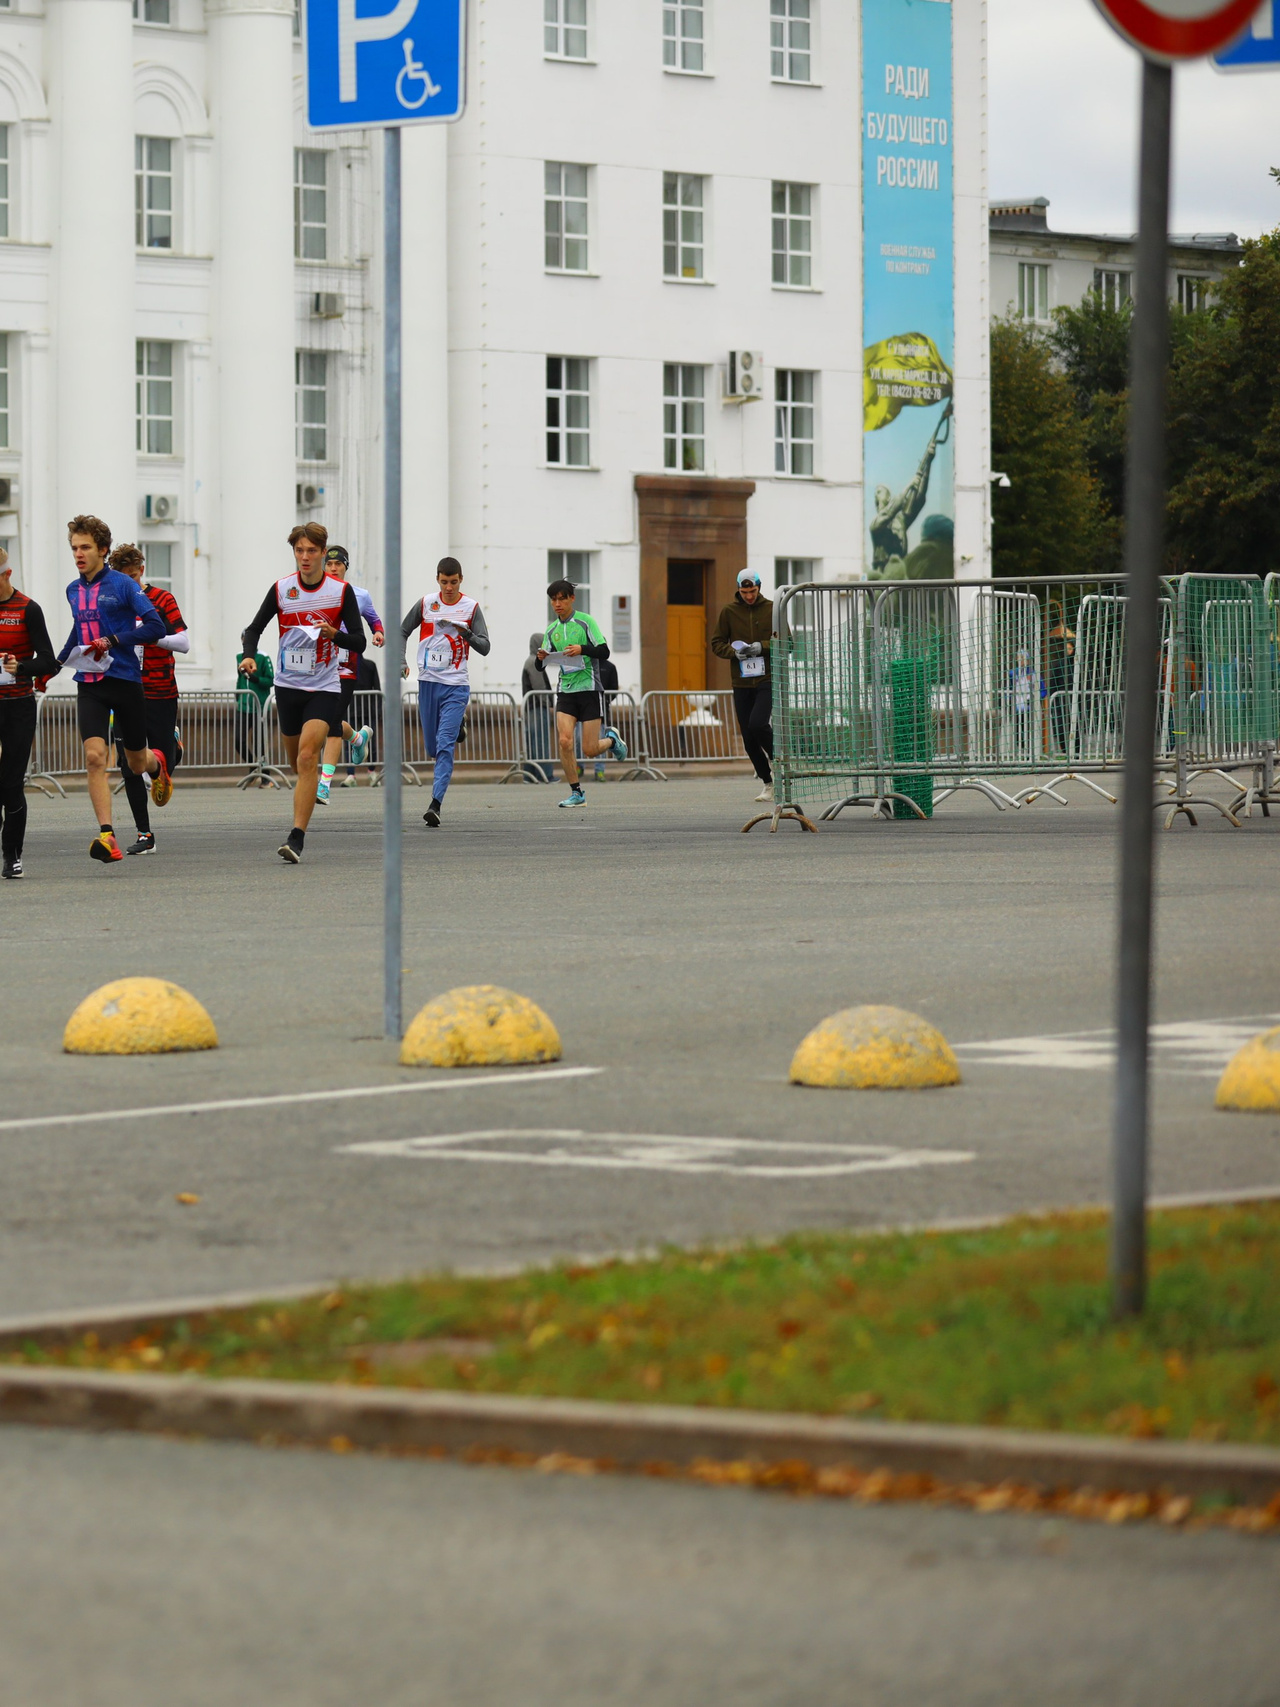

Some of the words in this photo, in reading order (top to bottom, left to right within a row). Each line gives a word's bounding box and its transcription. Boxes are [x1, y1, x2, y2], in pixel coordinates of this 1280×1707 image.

[885, 64, 930, 100] РАДИ
[867, 111, 948, 146] БУДУЩЕГО
[877, 155, 940, 191] РОССИИ
[908, 245, 936, 259] СЛУЖБА
[939, 371, 948, 385] 39
[892, 384, 912, 398] (8422)
[291, 654, 303, 664] 1.1
